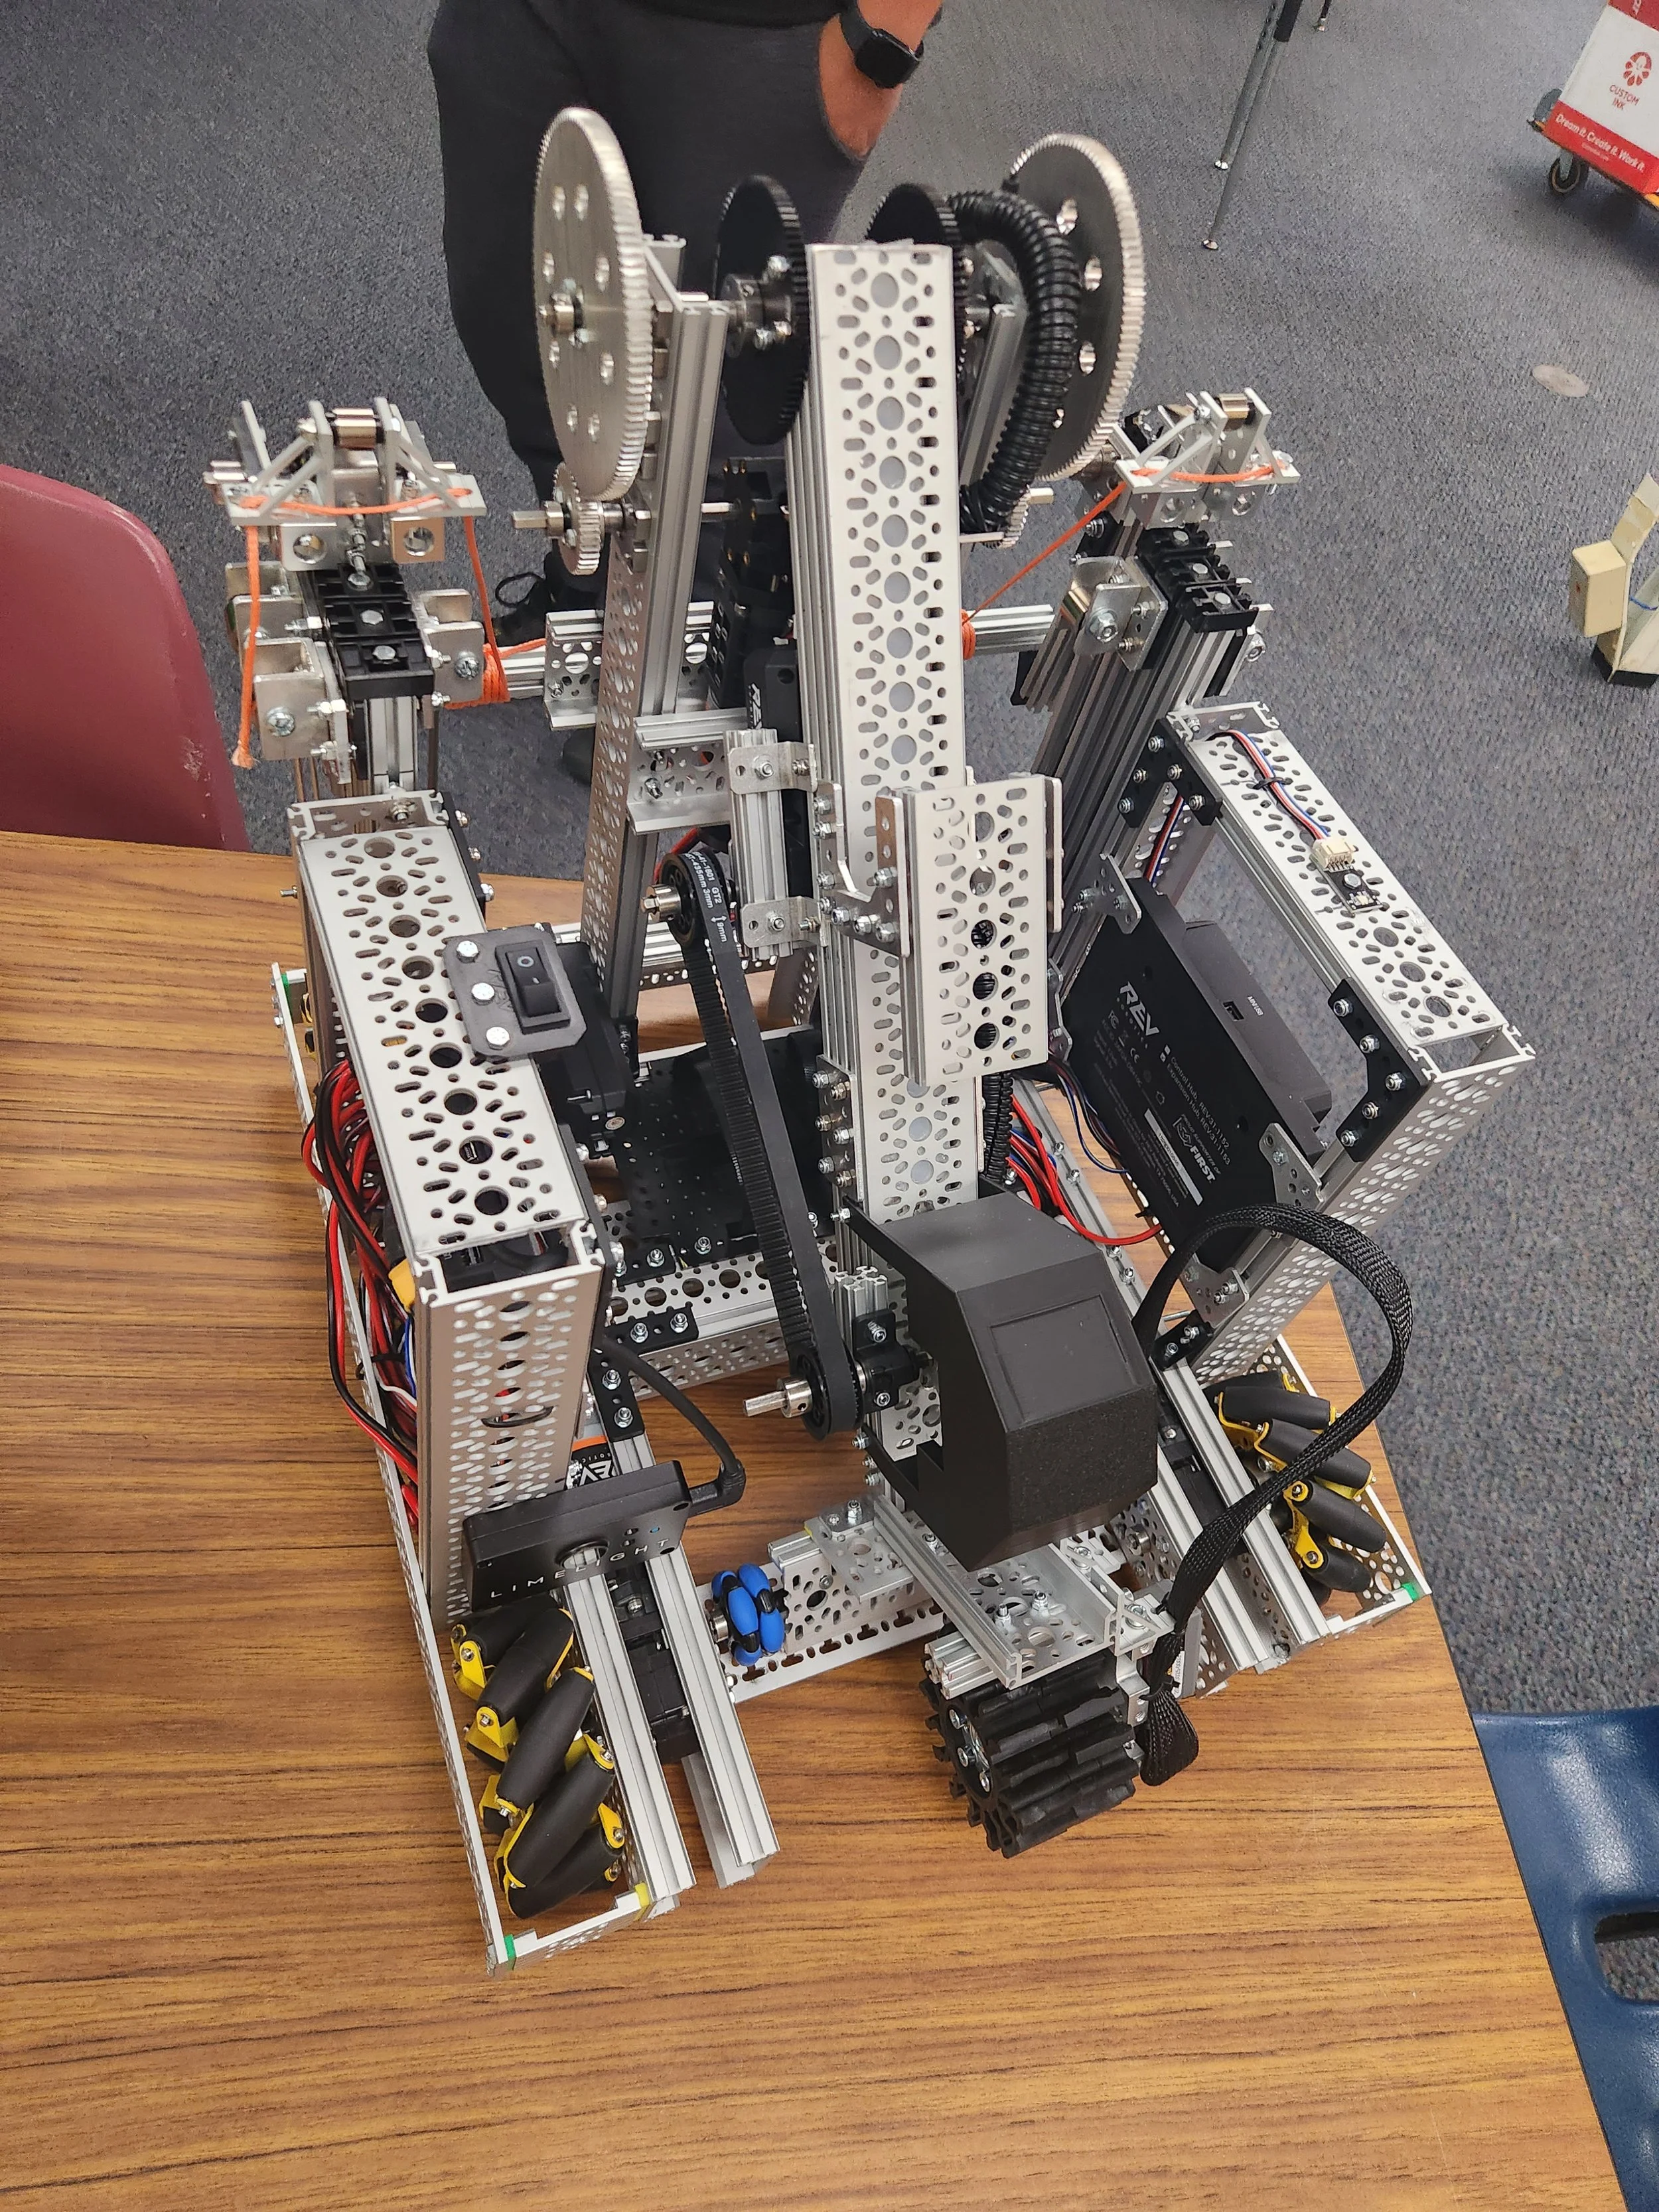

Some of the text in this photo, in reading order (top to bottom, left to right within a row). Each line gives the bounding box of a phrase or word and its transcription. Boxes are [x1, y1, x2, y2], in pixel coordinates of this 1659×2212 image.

[1609, 84, 1640, 105] CUSTOM
[1612, 99, 1625, 110] INK
[1555, 113, 1579, 134] Dream
[1587, 131, 1611, 151] Create
[1619, 148, 1639, 167] Work
[703, 889, 714, 909] 3mm
[711, 887, 723, 904] GT2
[716, 922, 727, 942] 9mm
[1119, 981, 1160, 1036] REV
[1166, 1063, 1190, 1102] Expansion
[1200, 1118, 1231, 1165] REV-31-1153
[1170, 1056, 1189, 1084] Control
[1198, 1102, 1230, 1150] REV-31-1152
[1180, 1114, 1195, 1133] PROUD
[1193, 1134, 1216, 1167] SUPPORTER
[490, 1538, 670, 1599] LIMELIGHT
